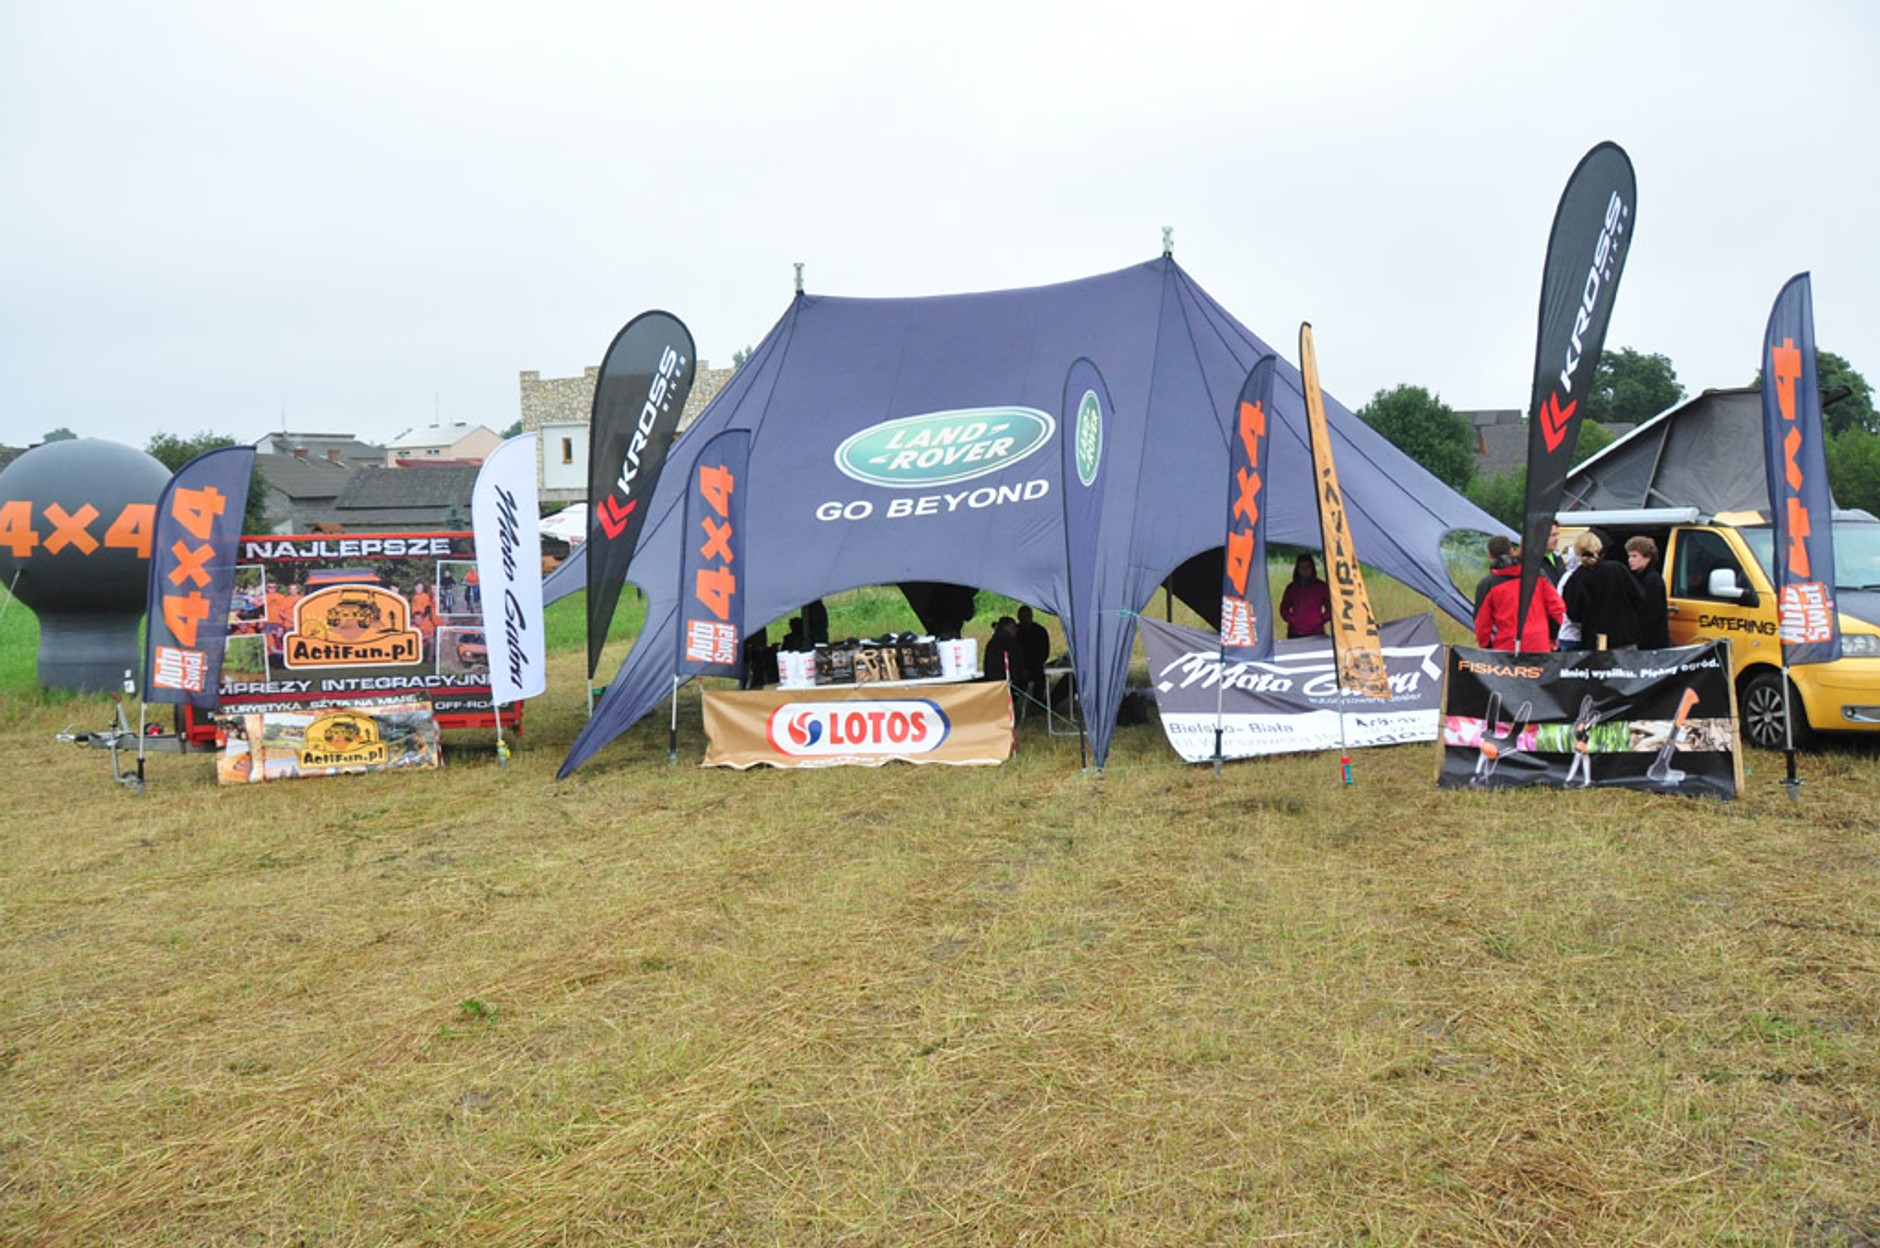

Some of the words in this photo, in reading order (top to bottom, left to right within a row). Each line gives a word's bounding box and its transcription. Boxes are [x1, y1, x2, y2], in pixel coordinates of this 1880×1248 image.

[1560, 191, 1621, 393] KROSS
[617, 345, 677, 495] KROSS
[885, 422, 988, 450] LAND
[888, 437, 1015, 470] ROVER
[815, 500, 873, 521] GO
[886, 479, 1050, 518] BEYOND
[1226, 400, 1265, 597] 4x4
[0, 501, 157, 559] 4x4
[245, 538, 451, 559] NAJLEPSZE
[696, 465, 736, 620] 4x4
[163, 485, 226, 647] 4x4
[1698, 614, 1776, 635] CATERING
[1780, 585, 1806, 643] Auto
[293, 639, 413, 660] ActiFun.pl
[688, 622, 714, 662] Auto
[154, 648, 182, 689] Auto
[219, 681, 312, 694] MPREZY
[322, 672, 490, 691] INTEGRACYJN
[1458, 661, 1541, 679] FISKARS
[829, 711, 927, 745] LOTOS
